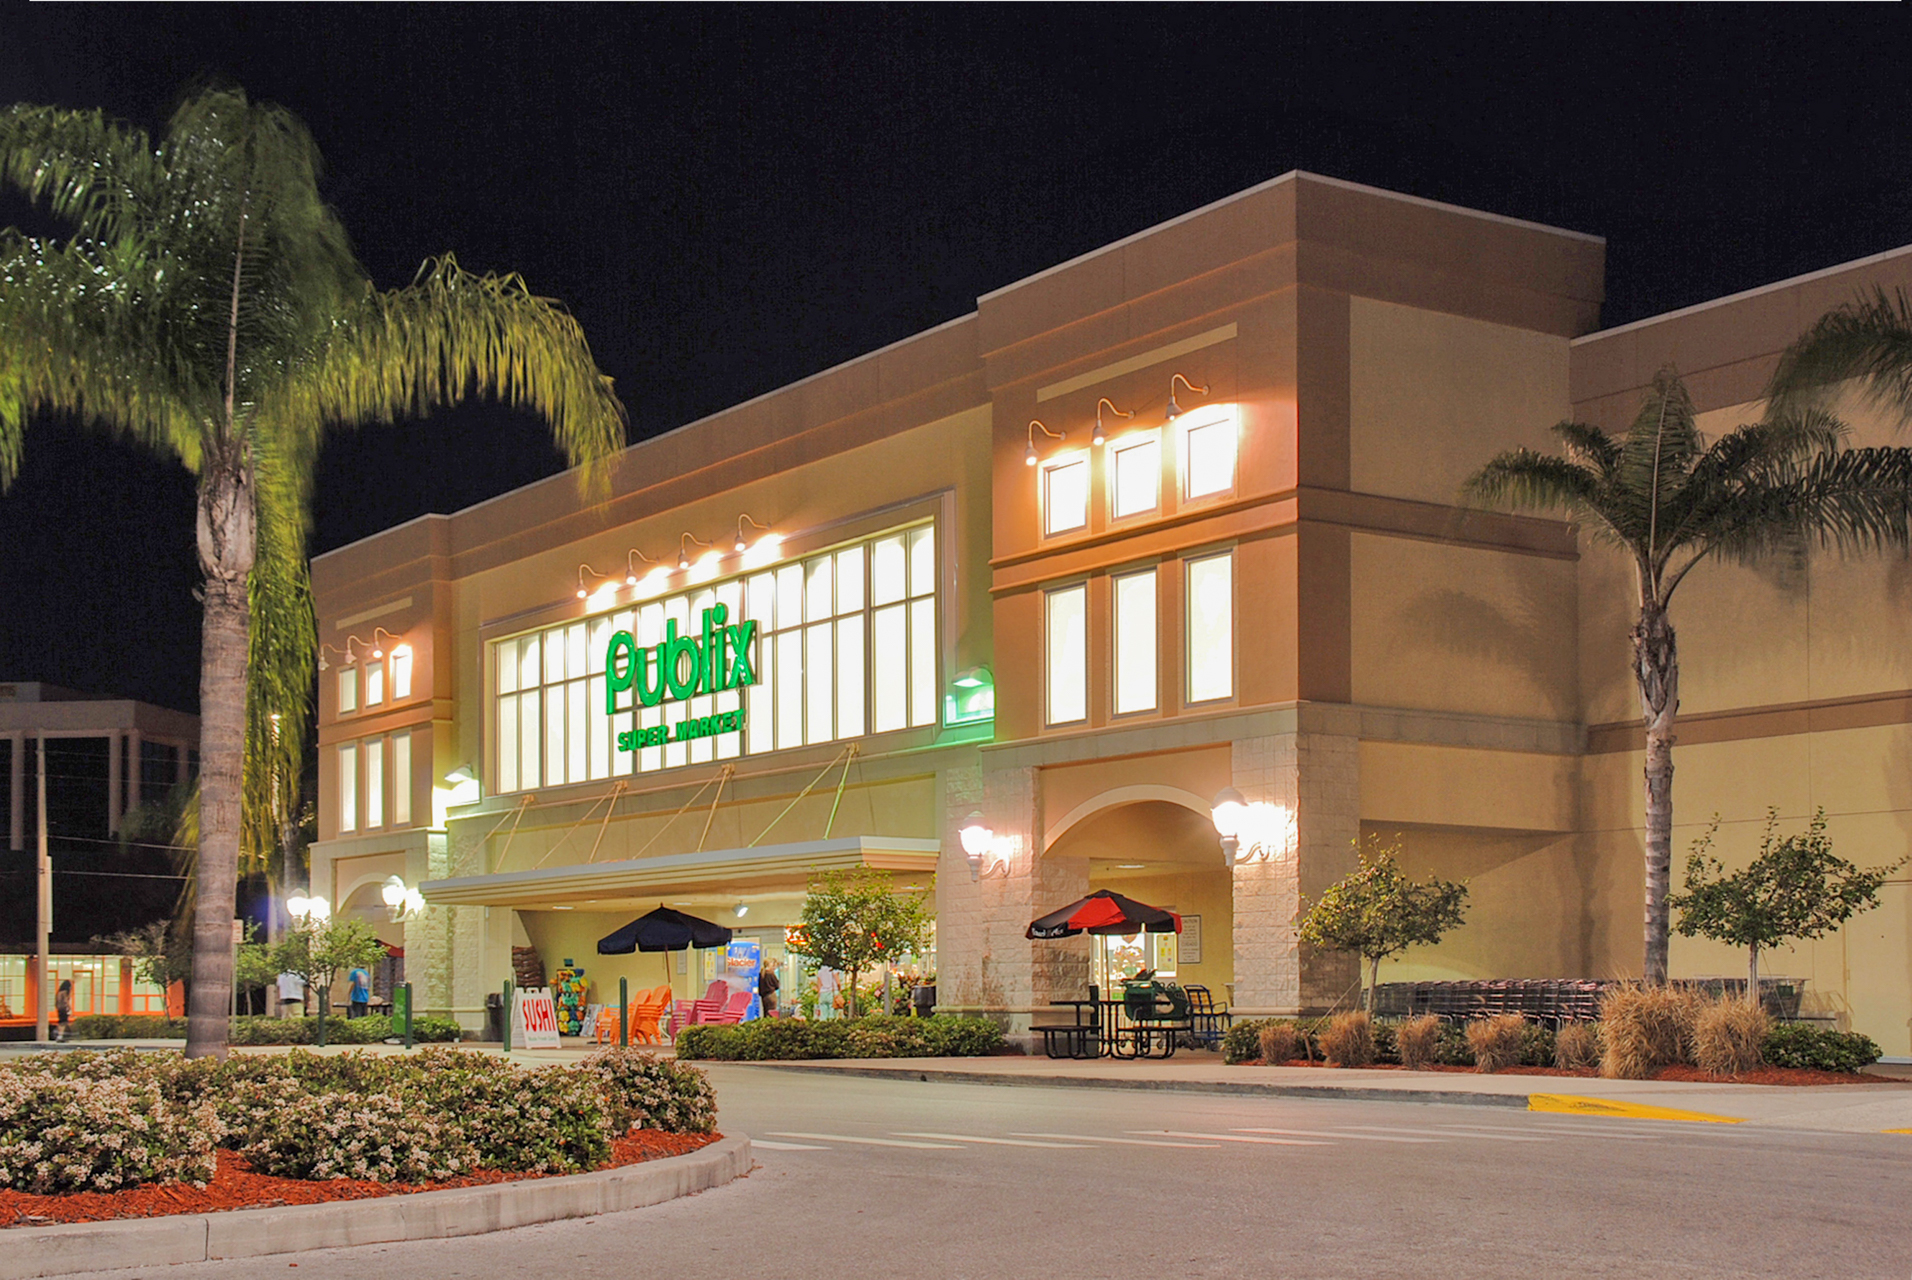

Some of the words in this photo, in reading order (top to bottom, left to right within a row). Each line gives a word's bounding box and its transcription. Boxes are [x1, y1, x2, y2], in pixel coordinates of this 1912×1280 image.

[606, 602, 758, 715] Publix
[618, 724, 669, 752] SUPER
[675, 708, 745, 742] MARKET
[522, 998, 557, 1032] SUSHI
